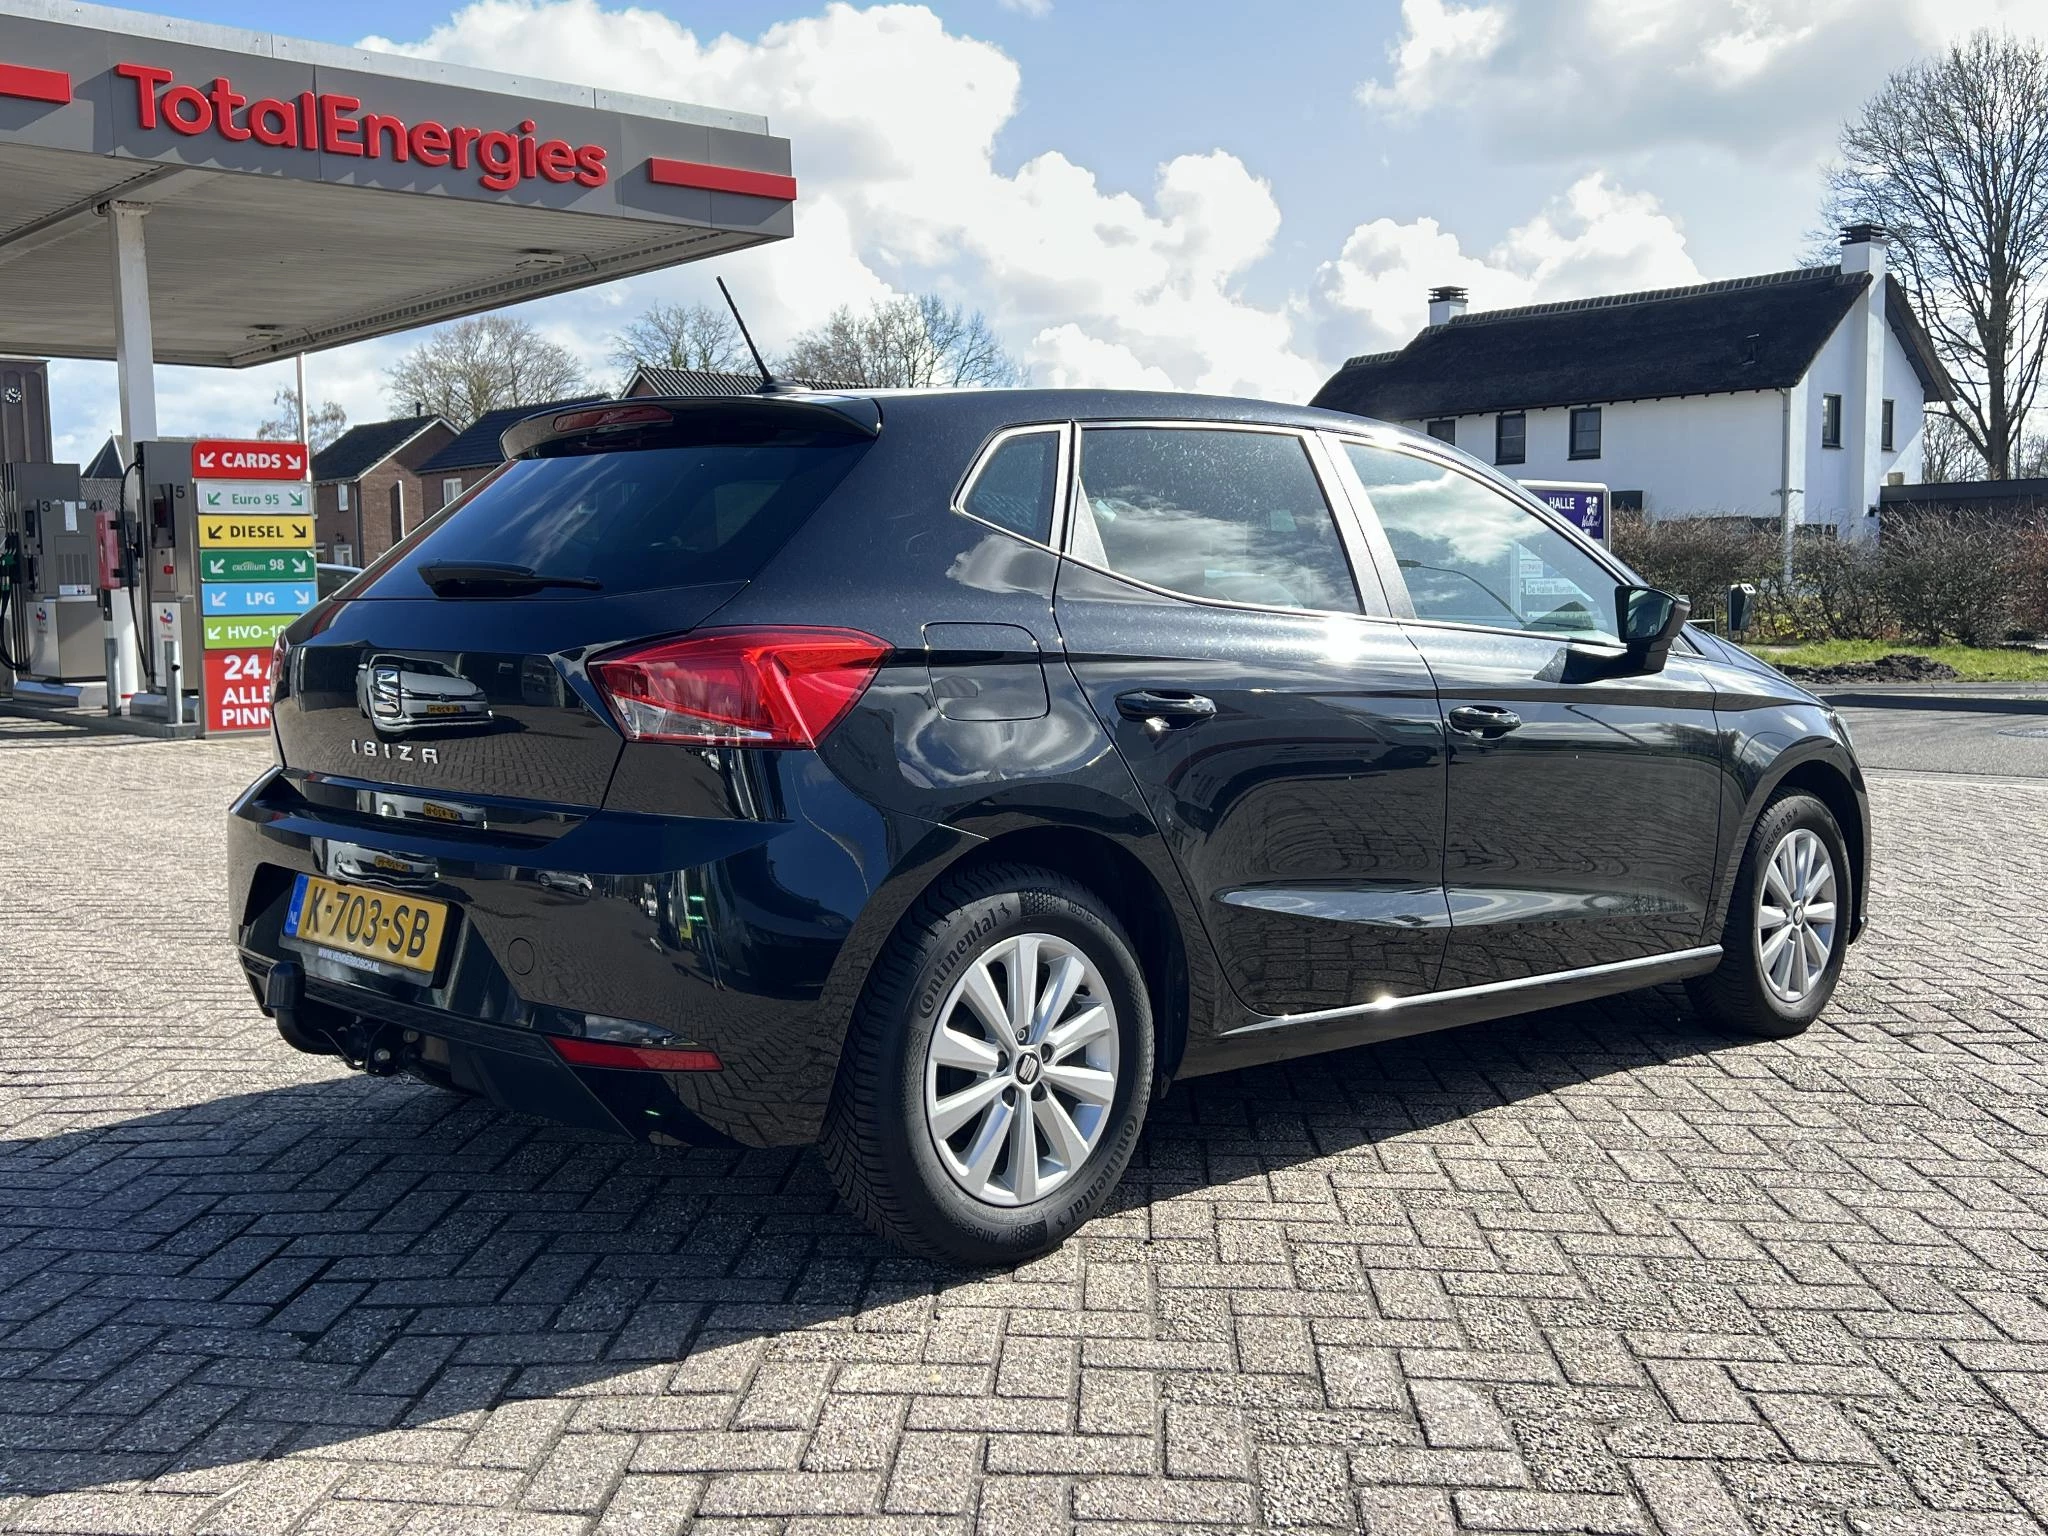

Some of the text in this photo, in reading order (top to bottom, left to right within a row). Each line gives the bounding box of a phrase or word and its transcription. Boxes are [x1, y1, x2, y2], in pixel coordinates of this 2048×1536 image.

[114, 63, 608, 191] TotalEnergies
[221, 452, 282, 469] CARDS
[175, 485, 185, 498] 5
[231, 493, 280, 505] Euro 95
[1549, 496, 1575, 510] HALLE
[42, 501, 51, 513] 3
[89, 501, 97, 513] 4
[230, 525, 285, 538] DIESEL
[269, 559, 285, 571] 98
[246, 592, 275, 606] LPG
[351, 739, 438, 765] IBIZA
[288, 911, 298, 925] NL
[306, 886, 429, 958] K-703-SB
[918, 907, 998, 1018] Continental
[1068, 1115, 1139, 1218] Continental
